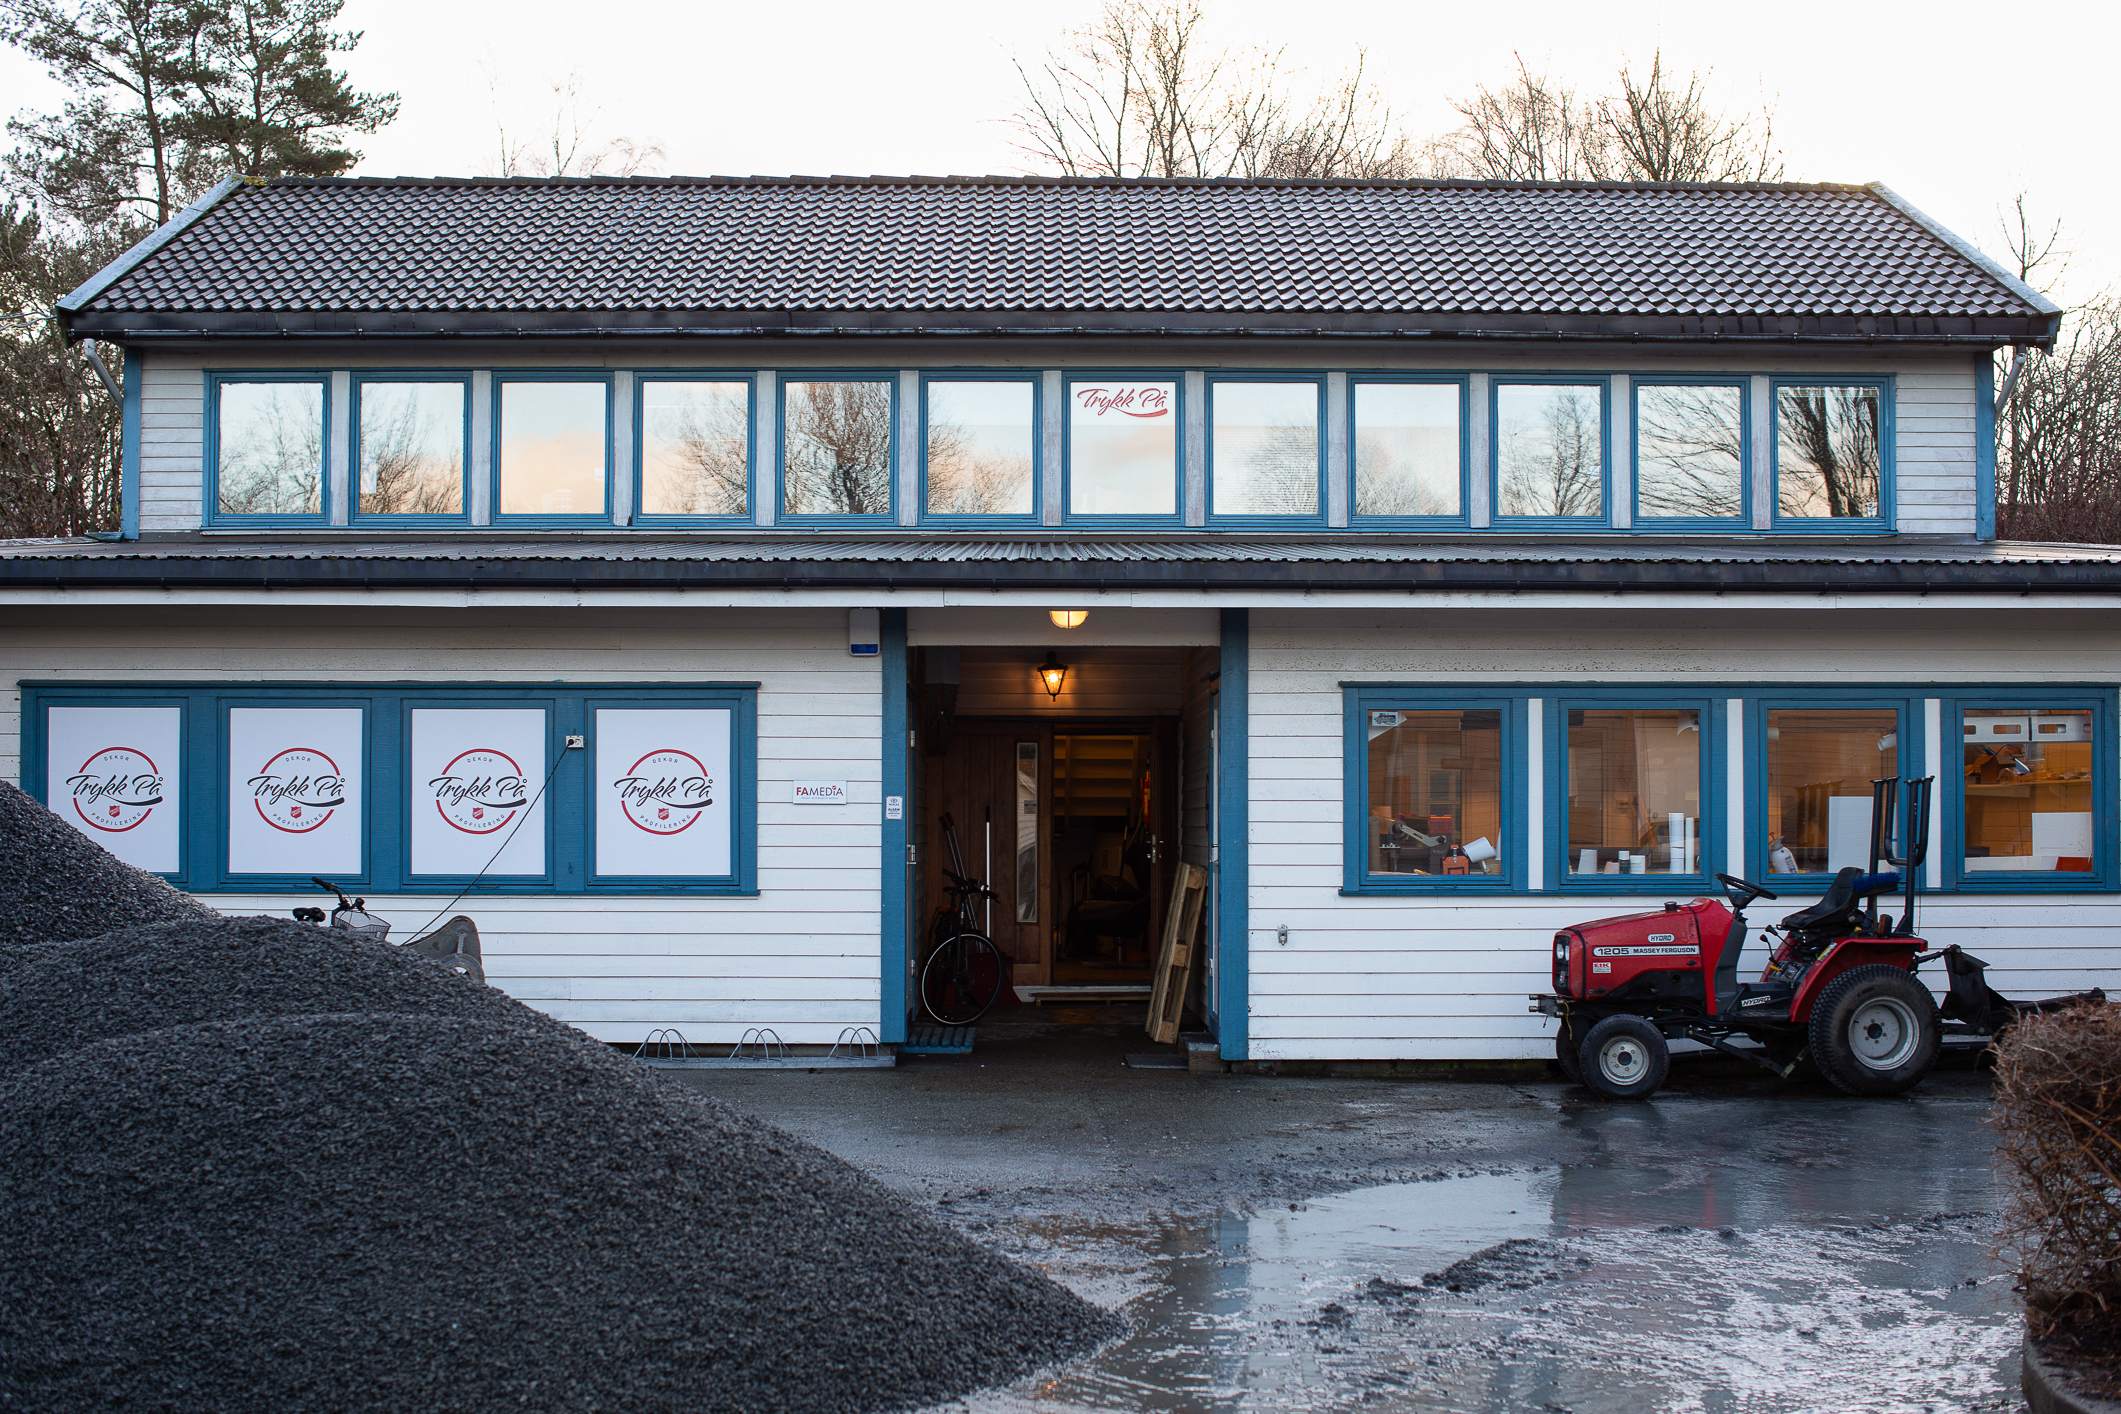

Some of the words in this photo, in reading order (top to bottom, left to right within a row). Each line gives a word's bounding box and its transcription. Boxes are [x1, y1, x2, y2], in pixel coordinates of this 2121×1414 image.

[1077, 388, 1135, 416] Trykk
[1138, 388, 1168, 409] På
[65, 774, 128, 805] Trykk
[131, 774, 164, 796] På
[247, 775, 310, 806] Trykk
[313, 775, 346, 797] På
[428, 776, 491, 807] Trykk
[494, 776, 527, 798] På
[614, 776, 677, 807] Trykk
[680, 776, 713, 798] På
[91, 812, 142, 826] PROFILERING
[273, 813, 324, 827] PROFILERING
[454, 814, 505, 828] PROFILERING
[640, 814, 691, 828] PROFILERING
[1742, 996, 1770, 1005] HYDRO
